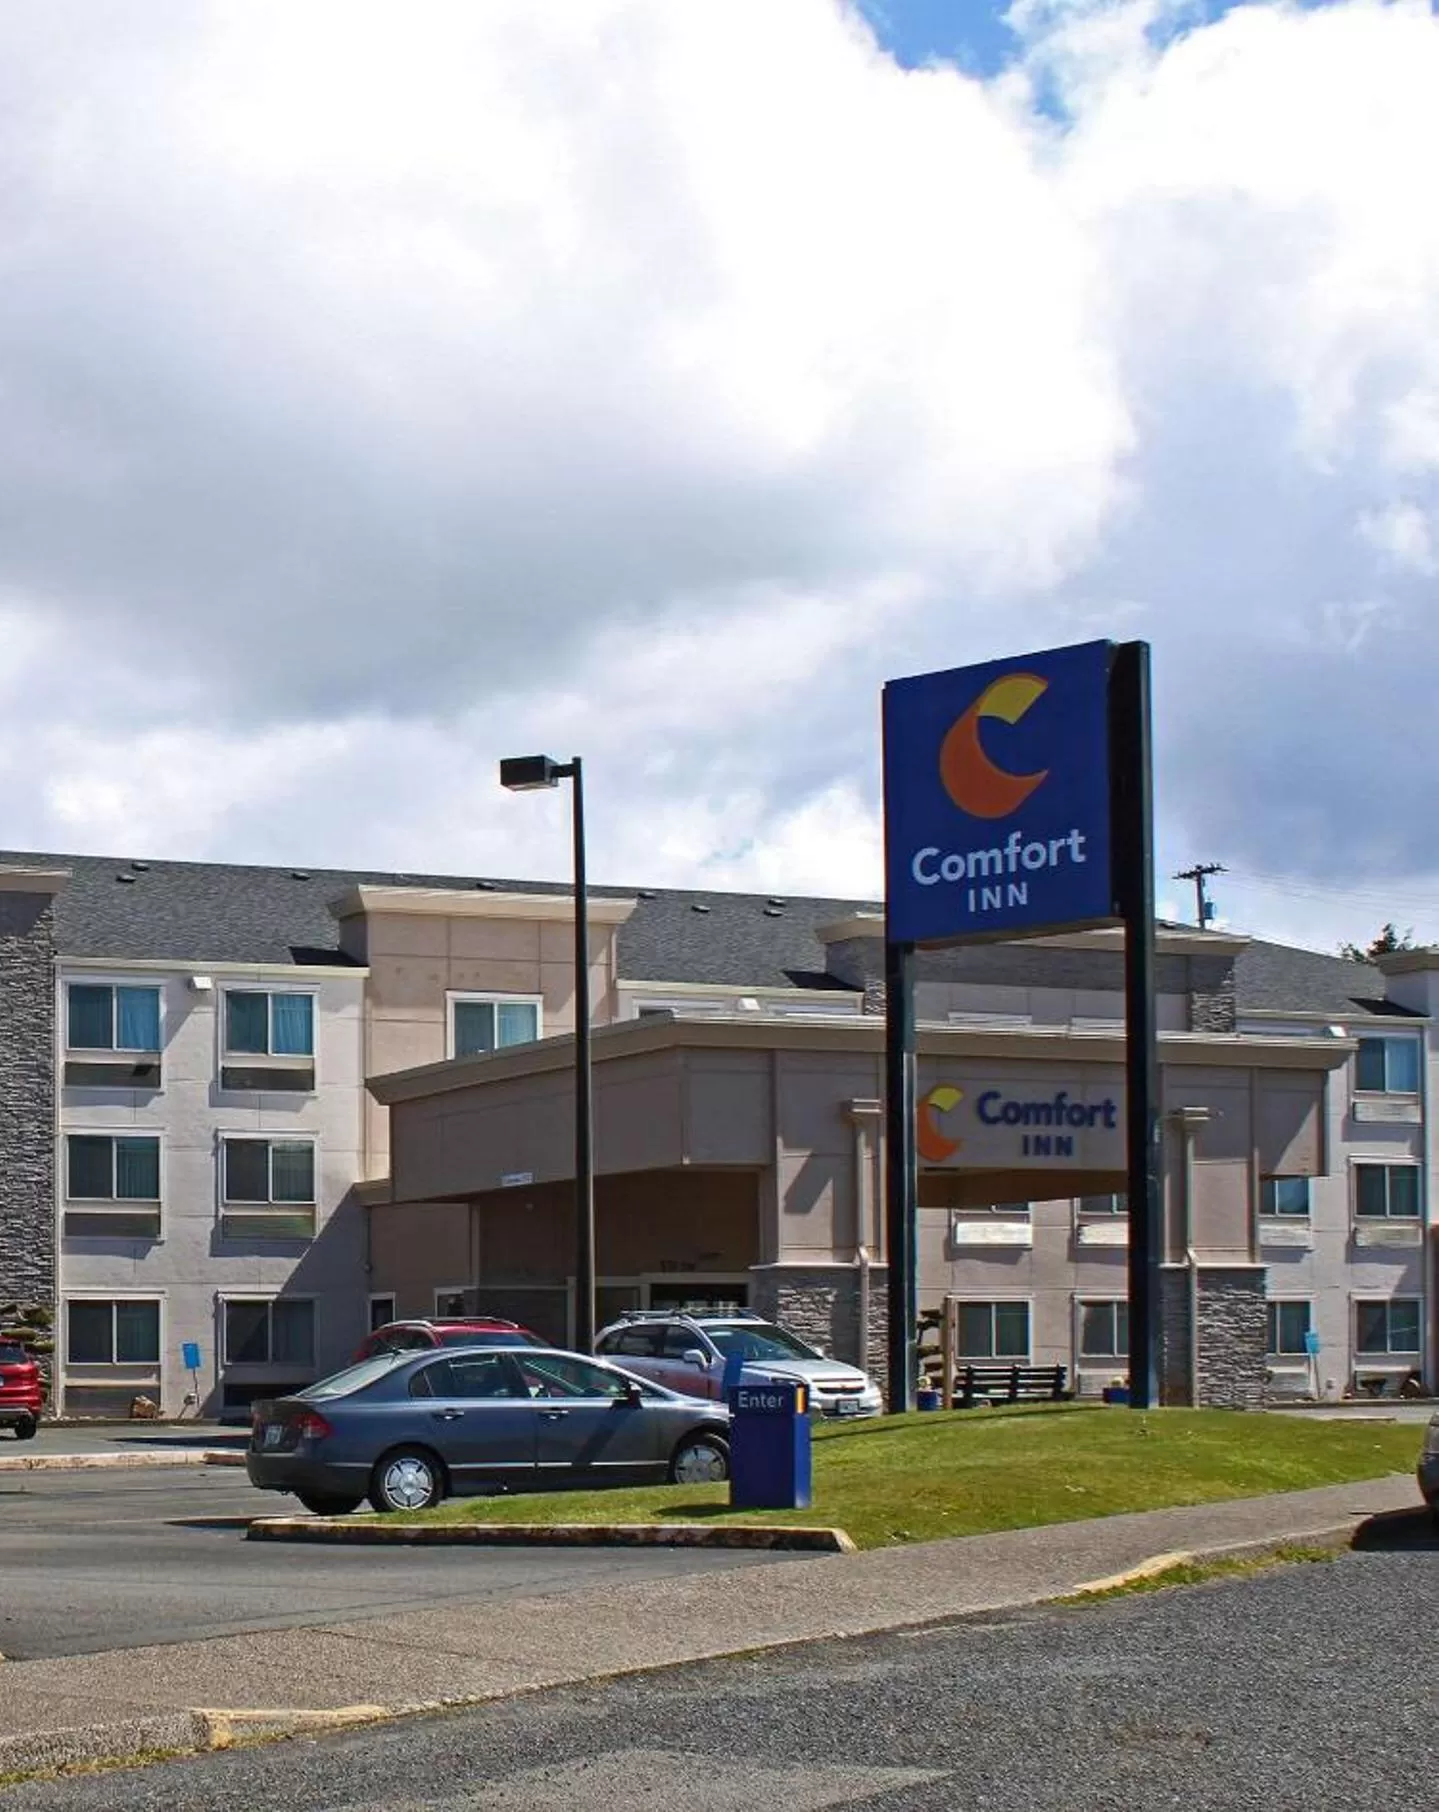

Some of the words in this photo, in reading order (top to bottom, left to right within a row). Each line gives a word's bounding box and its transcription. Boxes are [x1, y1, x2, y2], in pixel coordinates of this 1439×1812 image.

[912, 828, 1086, 886] Comfort
[968, 881, 1028, 912] INN
[976, 1090, 1117, 1128] Comfort
[1022, 1134, 1074, 1156] INN
[737, 1390, 784, 1409] Enter
